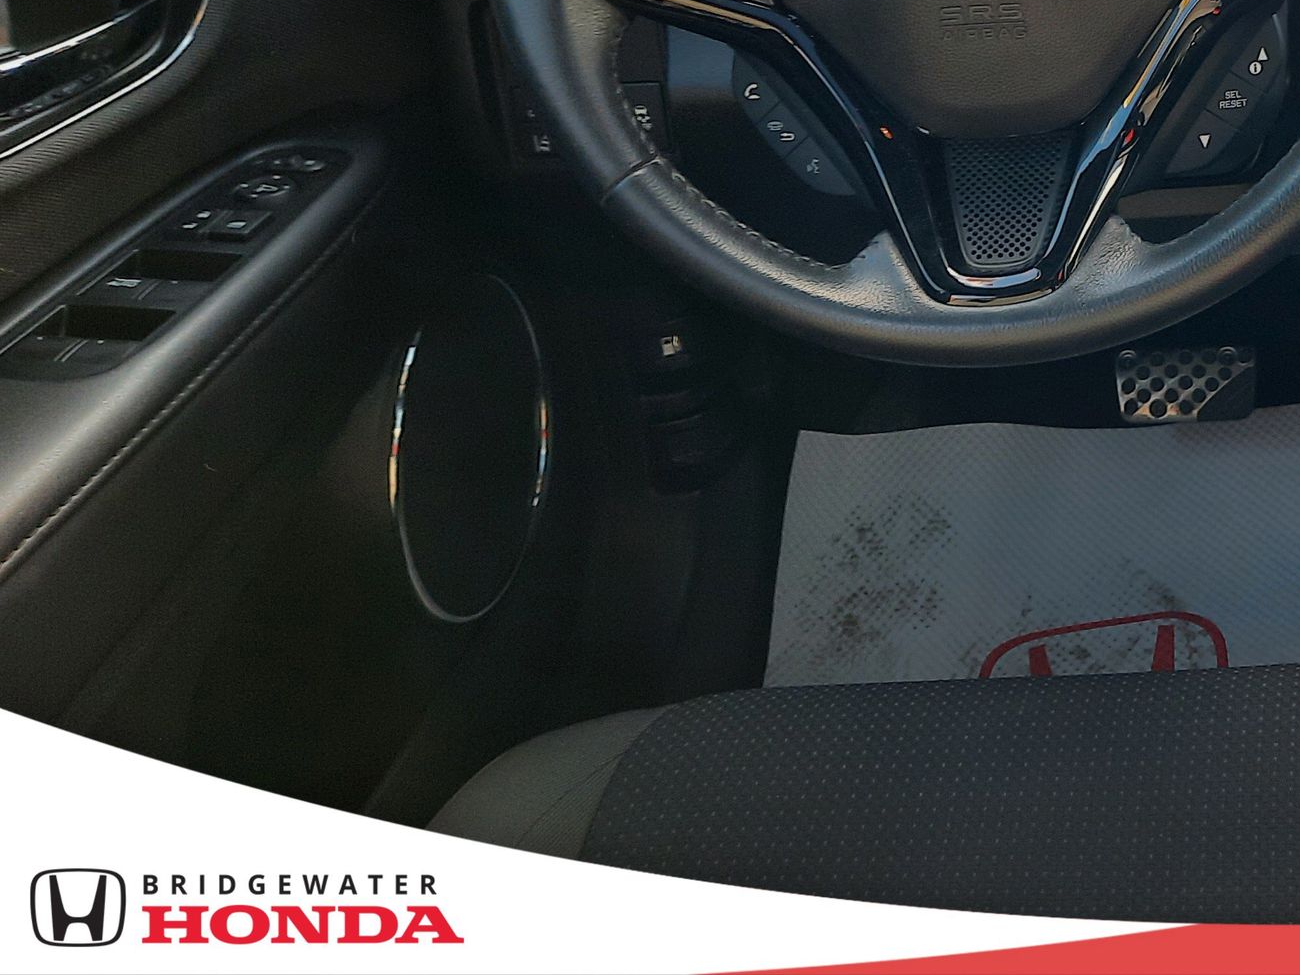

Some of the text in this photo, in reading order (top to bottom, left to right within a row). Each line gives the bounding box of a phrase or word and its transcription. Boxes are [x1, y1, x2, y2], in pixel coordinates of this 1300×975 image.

[941, 3, 1022, 22] SRS
[1225, 91, 1241, 99] SEL
[1219, 99, 1247, 109] RESET
